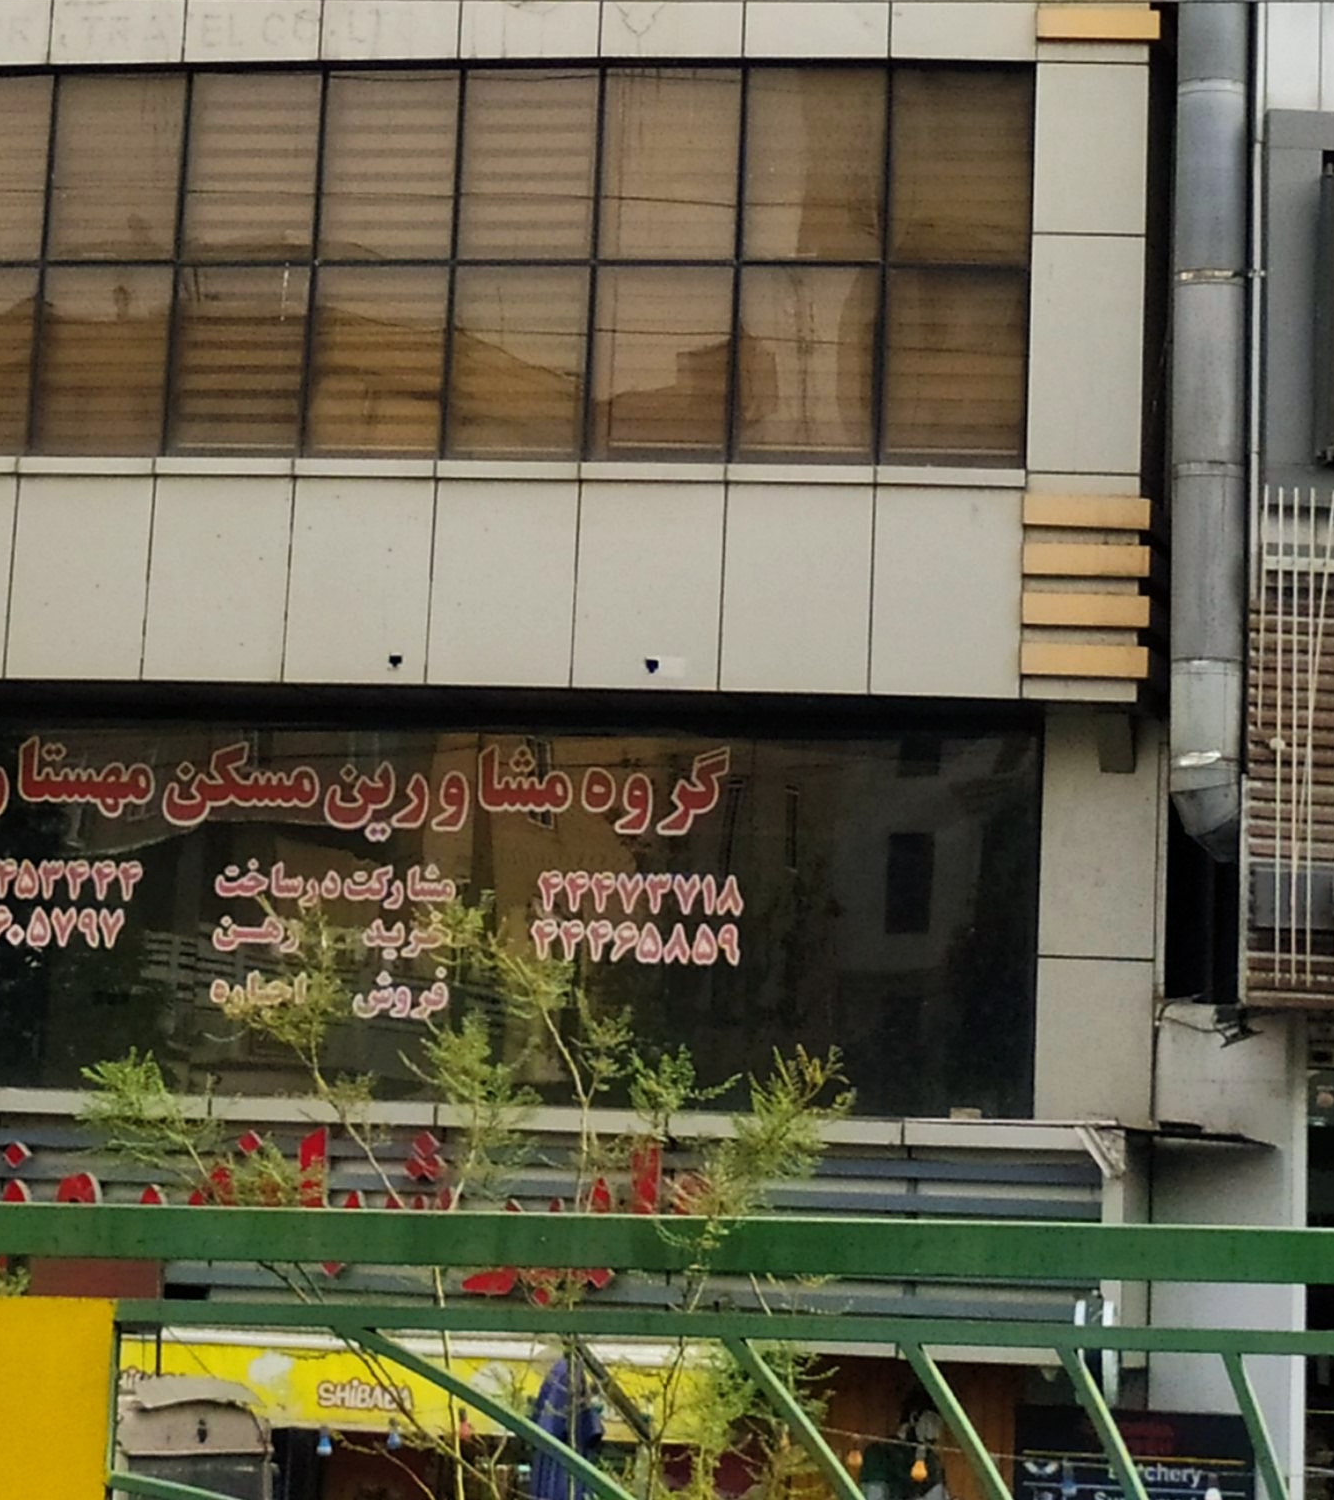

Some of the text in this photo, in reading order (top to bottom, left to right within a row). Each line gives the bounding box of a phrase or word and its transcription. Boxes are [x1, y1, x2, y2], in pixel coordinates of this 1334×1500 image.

[163, 742, 321, 827] مسکن
[323, 744, 573, 842] مشاورین
[580, 746, 731, 836] گروه
[214, 858, 457, 910] مشارکت در ساخت
[537, 869, 744, 917] ۴۴۴۷۳۷۱۸
[212, 911, 453, 961] خرید رهن
[530, 918, 741, 967] ۴۴۴۶۵۸۵۹
[352, 965, 450, 1020] فروش
